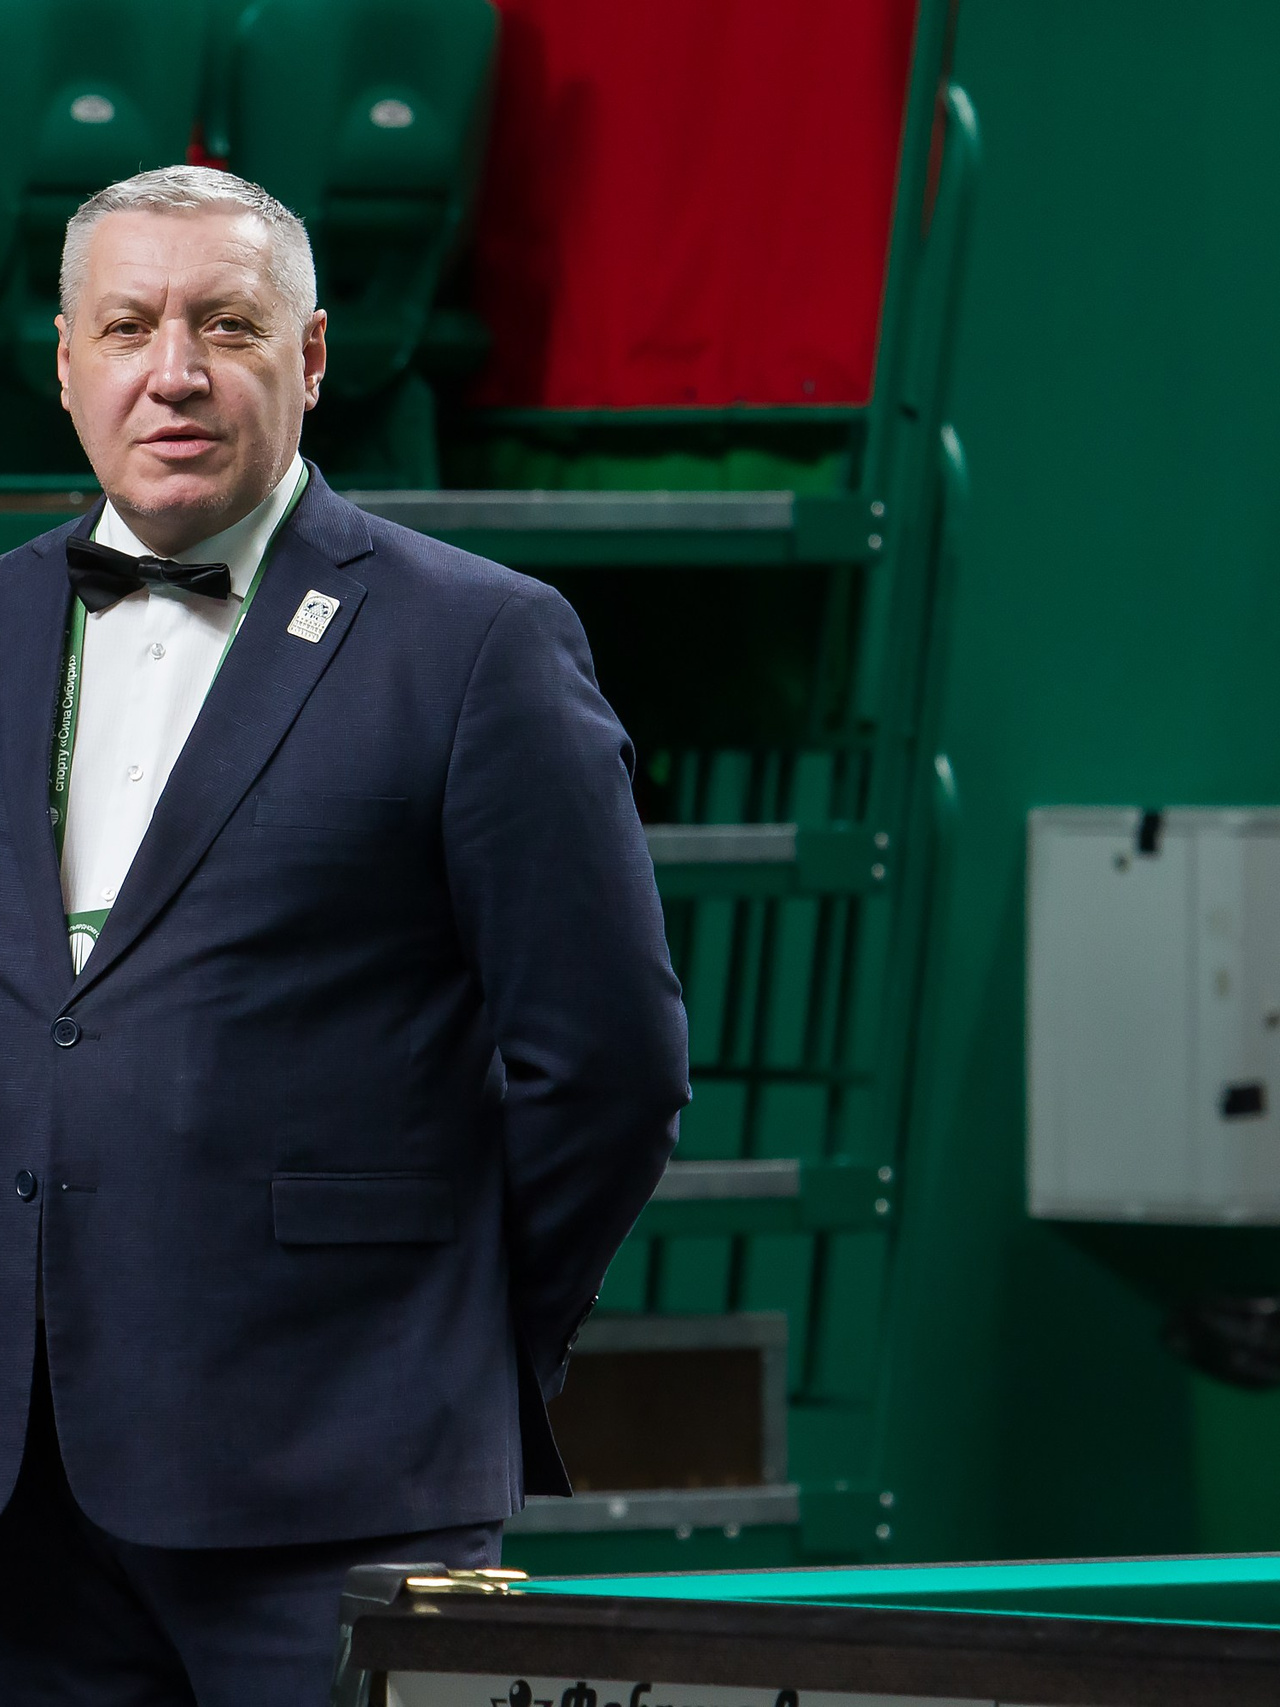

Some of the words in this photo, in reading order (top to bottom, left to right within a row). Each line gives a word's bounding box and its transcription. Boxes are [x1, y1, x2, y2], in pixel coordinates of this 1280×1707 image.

[62, 654, 77, 709] Сибири»
[58, 709, 73, 748] «Сила
[54, 749, 69, 792] спорту
